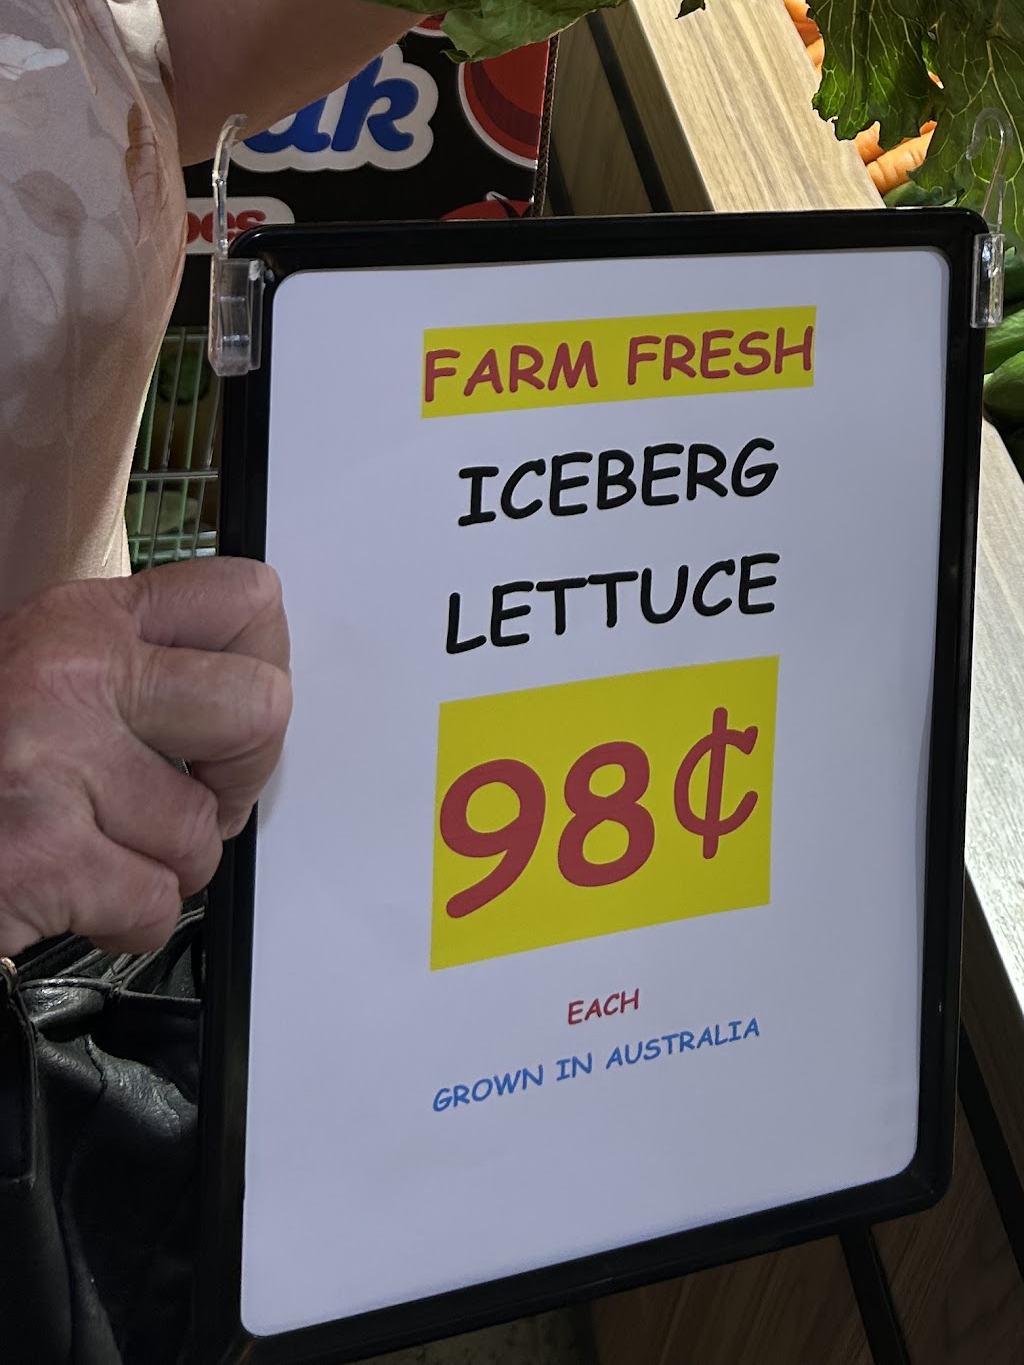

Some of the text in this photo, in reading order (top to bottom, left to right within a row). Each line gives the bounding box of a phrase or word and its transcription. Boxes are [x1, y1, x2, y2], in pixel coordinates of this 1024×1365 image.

[425, 325, 815, 403] FARM FRESH
[458, 437, 779, 527] ICEBERG
[446, 552, 780, 654] LETTUCE
[439, 706, 760, 920] 98¢
[566, 987, 641, 1026] EACH
[432, 1017, 761, 1113] GROWN IN AUSTRALIA
